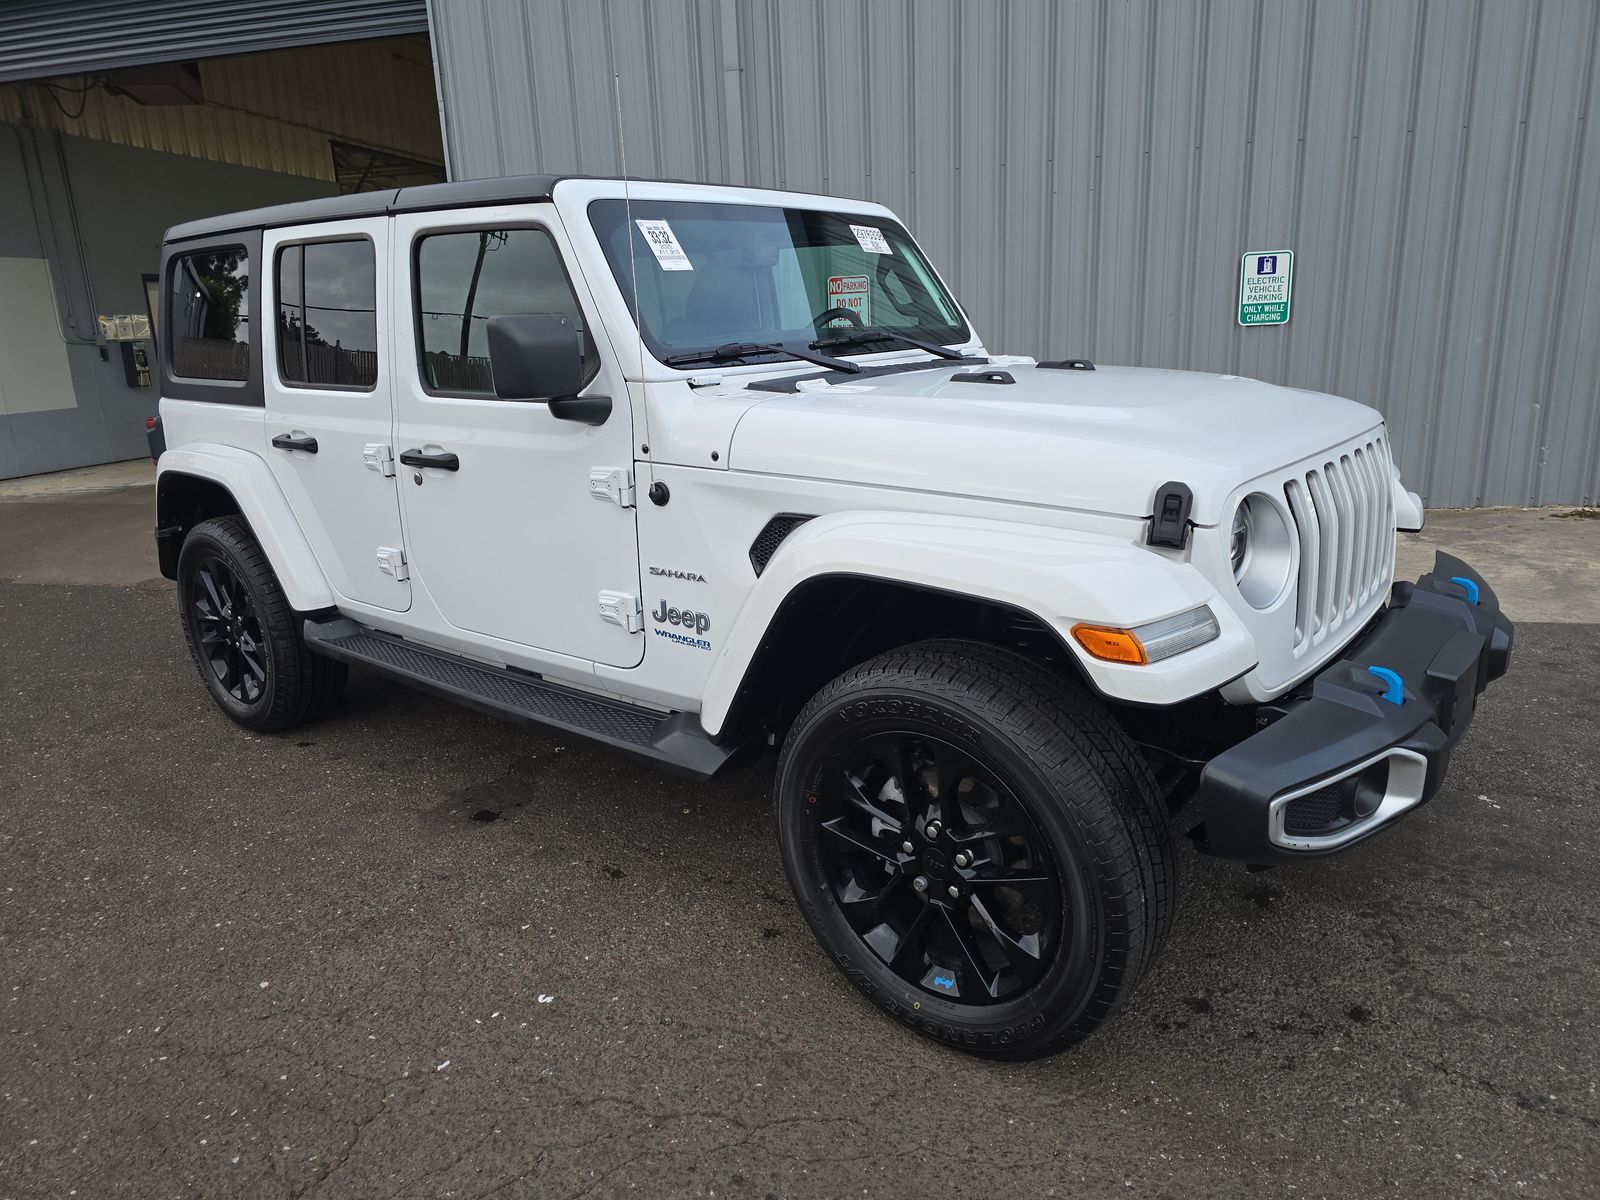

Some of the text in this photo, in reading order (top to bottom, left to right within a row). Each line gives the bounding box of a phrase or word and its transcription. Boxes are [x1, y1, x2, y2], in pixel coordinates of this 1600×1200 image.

[1247, 276, 1285, 285] ELECTRIC
[830, 280, 867, 293] NO PARKING
[1249, 285, 1283, 293] VEHICLE
[1247, 293, 1283, 302] PARKING
[836, 298, 862, 308] DO NOT
[1243, 304, 1285, 313] ONLY WHILE
[1246, 313, 1281, 322] CHARGING
[649, 566, 708, 583] SAHARA
[652, 599, 711, 635] Jeep
[654, 628, 711, 648] WRANGLER
[672, 640, 711, 651] UNLIMITED
[839, 699, 981, 744] YOKOHAMA
